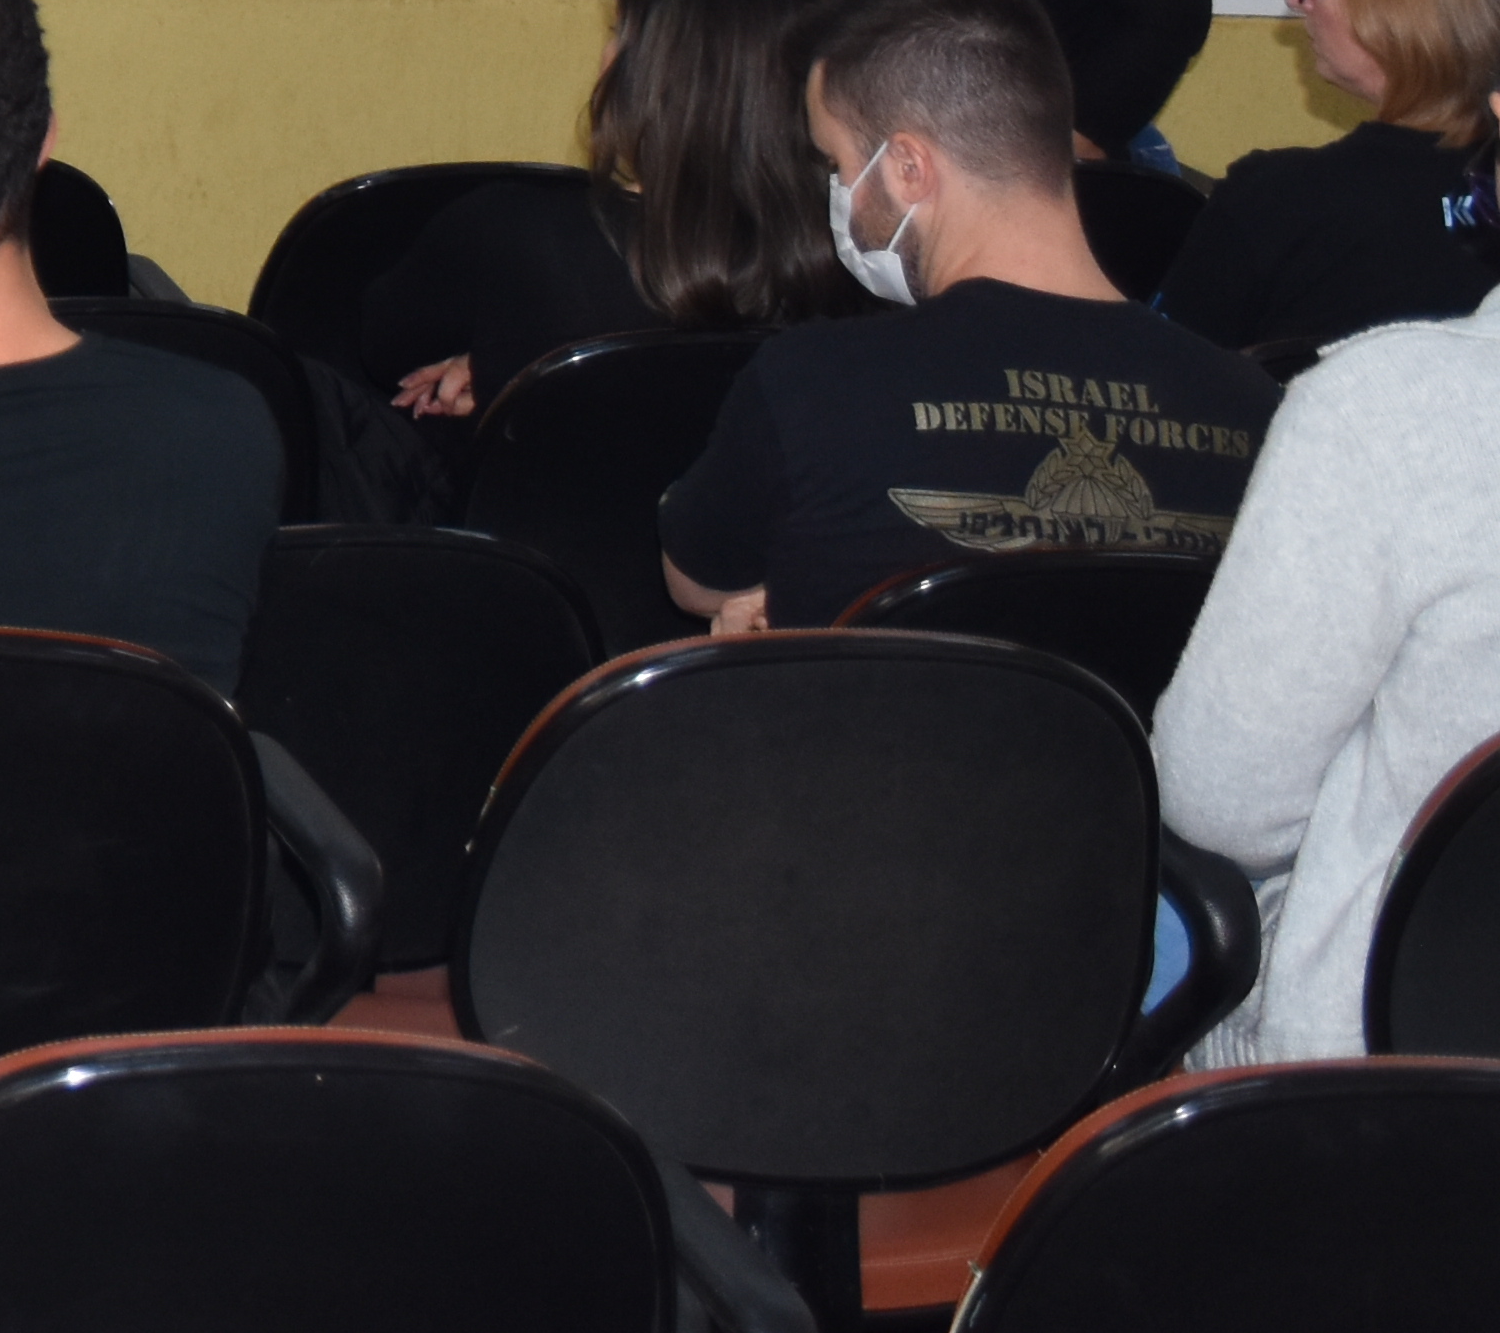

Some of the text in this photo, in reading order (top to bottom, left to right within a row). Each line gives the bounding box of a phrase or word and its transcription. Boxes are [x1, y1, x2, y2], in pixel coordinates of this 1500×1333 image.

[1004, 368, 1160, 414] ISRAEL
[912, 401, 1252, 459] DEFENSE FORCES
